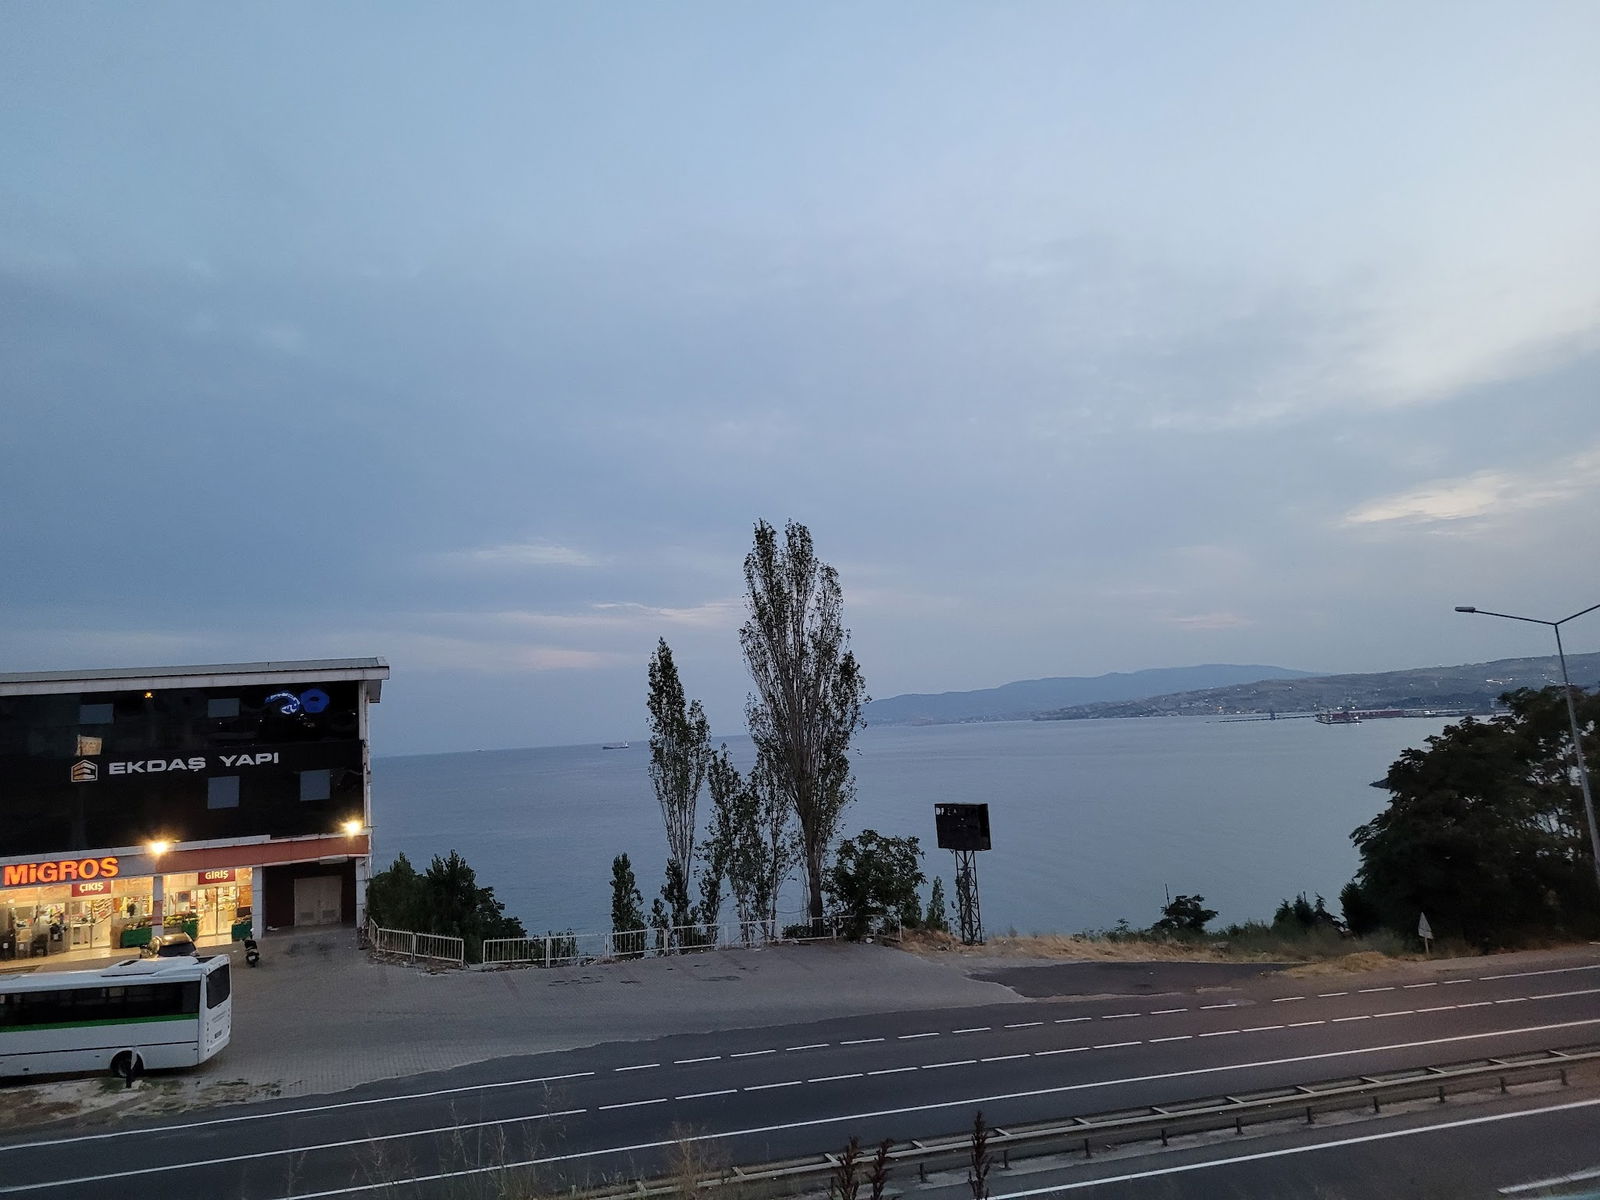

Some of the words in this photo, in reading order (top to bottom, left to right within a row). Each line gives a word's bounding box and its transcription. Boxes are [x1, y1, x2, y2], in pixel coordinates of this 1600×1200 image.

[108, 756, 206, 775] EKDAŞ
[219, 752, 279, 767] YAPI
[79, 881, 104, 894] ÇIKIŞ
